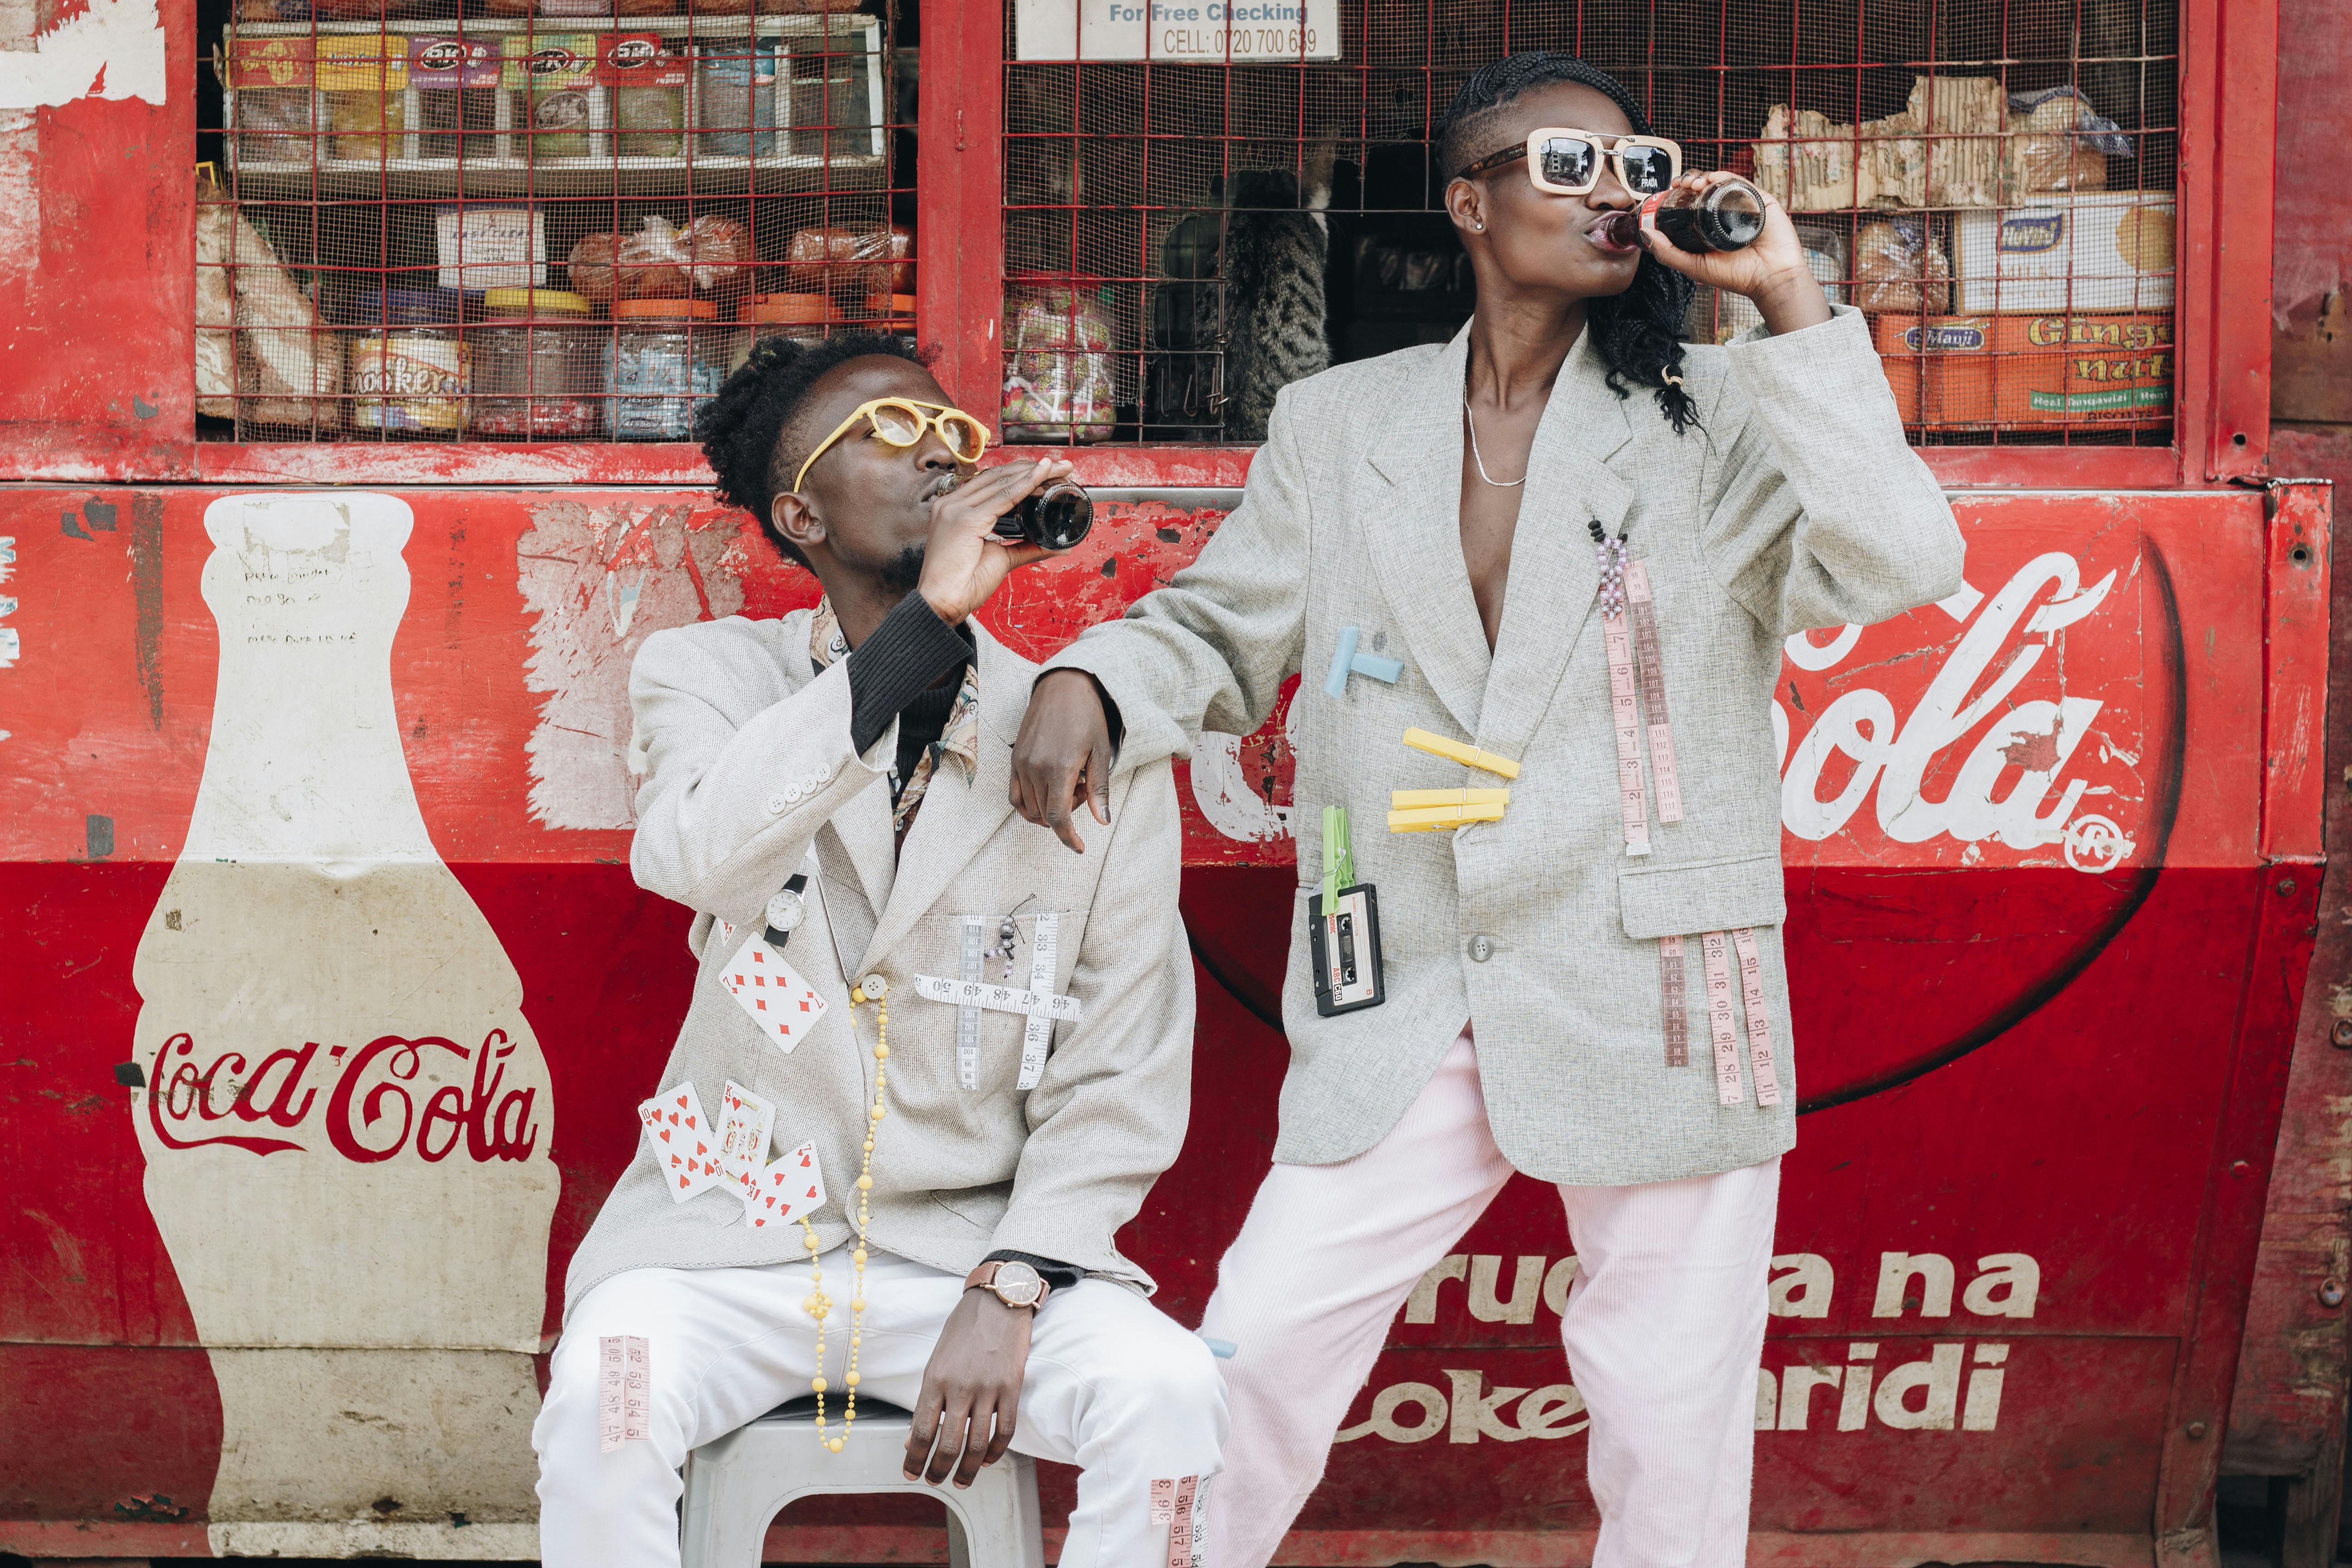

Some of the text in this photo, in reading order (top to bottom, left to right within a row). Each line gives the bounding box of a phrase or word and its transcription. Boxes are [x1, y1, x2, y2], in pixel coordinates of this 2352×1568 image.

[1110, 4, 1308, 24] For Free Checking
[1164, 29, 1209, 53] CELL:
[1215, 29, 1251, 53] 0720
[1257, 29, 1284, 53] 700
[1642, 179, 1657, 187] PRADA
[2033, 398, 2061, 407] Real
[1617, 667, 1628, 675] 6
[1621, 698, 1632, 706] 5
[1624, 729, 1635, 738] 4
[1627, 760, 1638, 769] 3
[1037, 934, 1049, 951] 33
[1710, 938, 1723, 958] 32
[1034, 964, 1046, 980] 34
[1333, 968, 1341, 983] ABC
[1714, 971, 1726, 989] 31
[723, 977, 731, 987] 7
[815, 998, 823, 1009] 7
[933, 980, 1070, 1010] 46 47 48 49 50
[1716, 1000, 1730, 1020] 30
[1739, 928, 1775, 1099] 11 12 13 14 15 16
[1028, 1024, 1040, 1042] 36
[1720, 1032, 1733, 1052] 29
[1024, 1054, 1036, 1073] 37
[1724, 1064, 1736, 1083] 28
[727, 1085, 733, 1097] K
[641, 1108, 650, 1121] 10
[715, 1165, 724, 1176] 10
[748, 1186, 755, 1197] K
[1872, 1252, 2040, 1318] na
[629, 1348, 642, 1363] 52
[629, 1371, 642, 1389] 53
[608, 1349, 621, 1442] 47 48 49 50
[628, 1399, 641, 1418] 54
[1329, 1369, 1589, 1444] oke
[1158, 1499, 1171, 1520] 36
[1173, 1526, 1184, 1545] 57
[1195, 1524, 1202, 1542] 53
